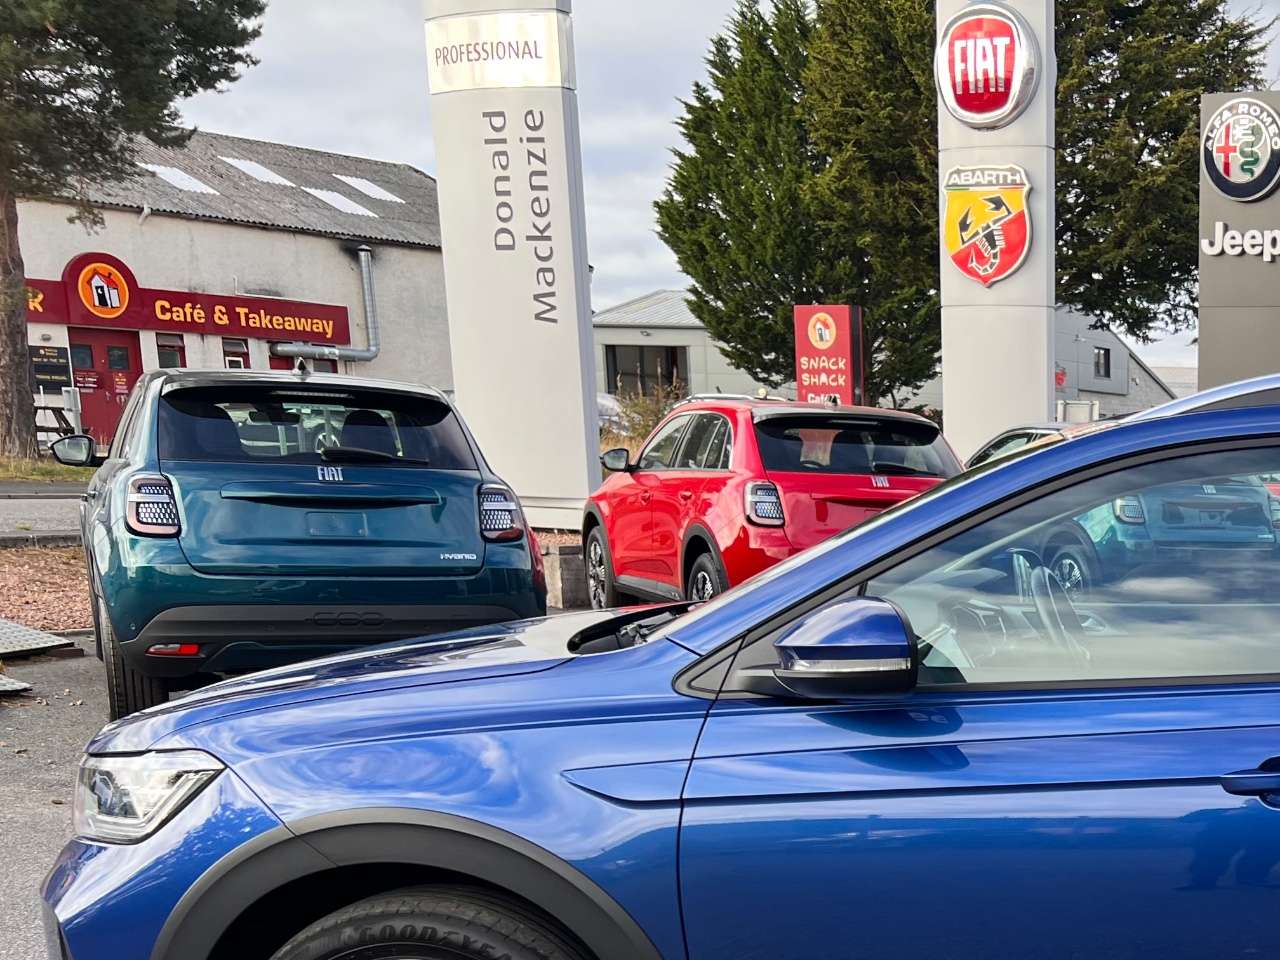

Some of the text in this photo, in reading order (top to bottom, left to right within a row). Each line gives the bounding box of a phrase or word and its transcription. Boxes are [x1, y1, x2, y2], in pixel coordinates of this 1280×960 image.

[435, 40, 543, 67] PROFESSIONAL
[954, 37, 1010, 94] FIAT
[1206, 103, 1280, 151] ALFA ROMEO
[482, 111, 516, 251] Donald
[948, 170, 1021, 185] ABARTH
[519, 109, 558, 323] Mackenzie
[155, 300, 334, 338] Café & Takeaway
[800, 356, 846, 370] SNACK
[801, 373, 846, 386] SHACK
[317, 466, 344, 481] FIAT
